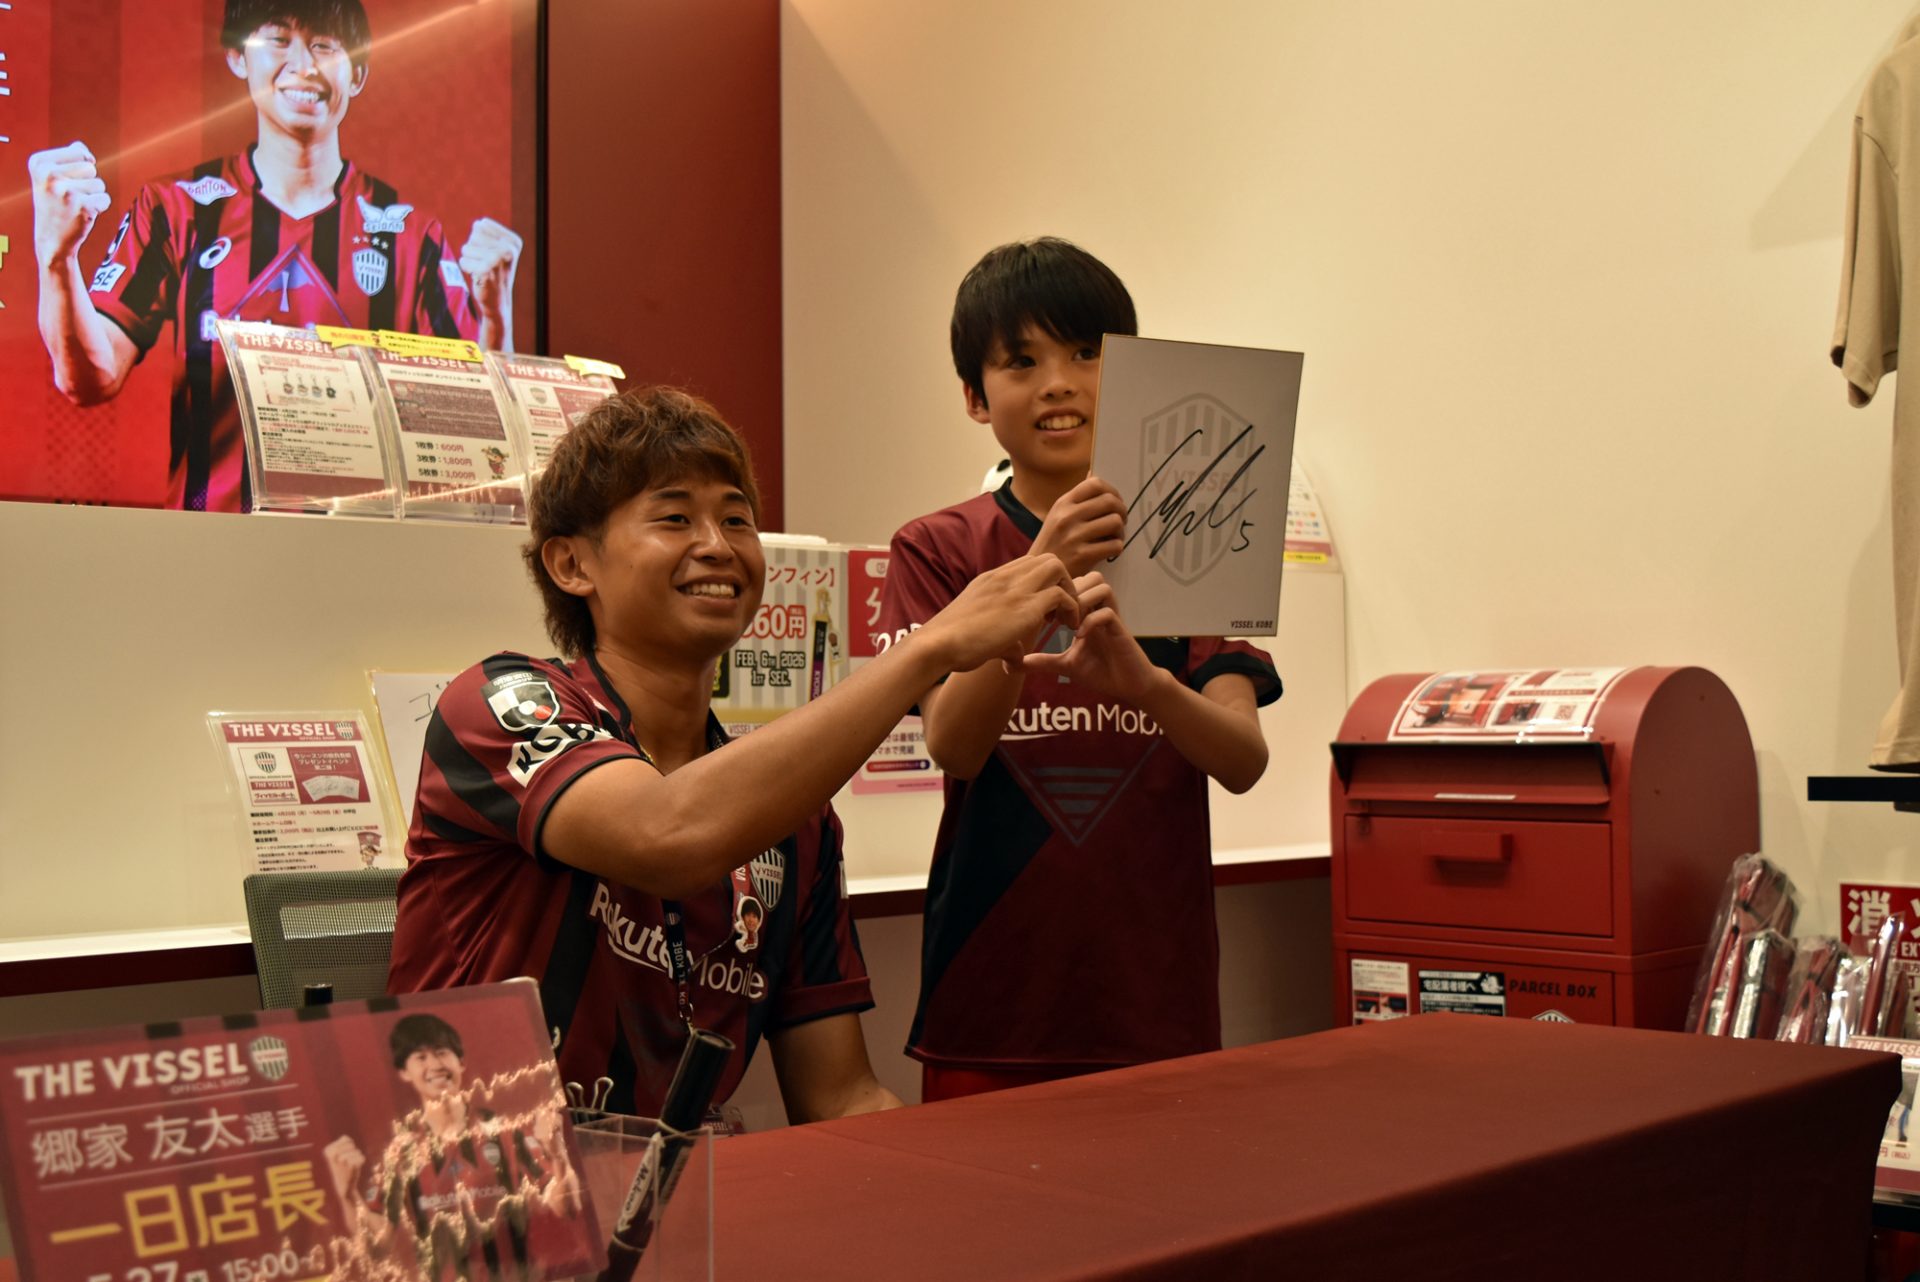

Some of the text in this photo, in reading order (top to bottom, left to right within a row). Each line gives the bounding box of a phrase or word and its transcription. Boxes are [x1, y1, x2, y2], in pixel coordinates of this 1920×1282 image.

[239, 334, 333, 354] THE VISSEL
[507, 363, 534, 376] THE
[745, 605, 806, 639] 60円
[228, 722, 335, 737] THE VISSEL
[1509, 979, 1598, 998] PARCEL BOX
[14, 1043, 249, 1101] THE VISSEL
[50, 1160, 330, 1258] 一日店長
